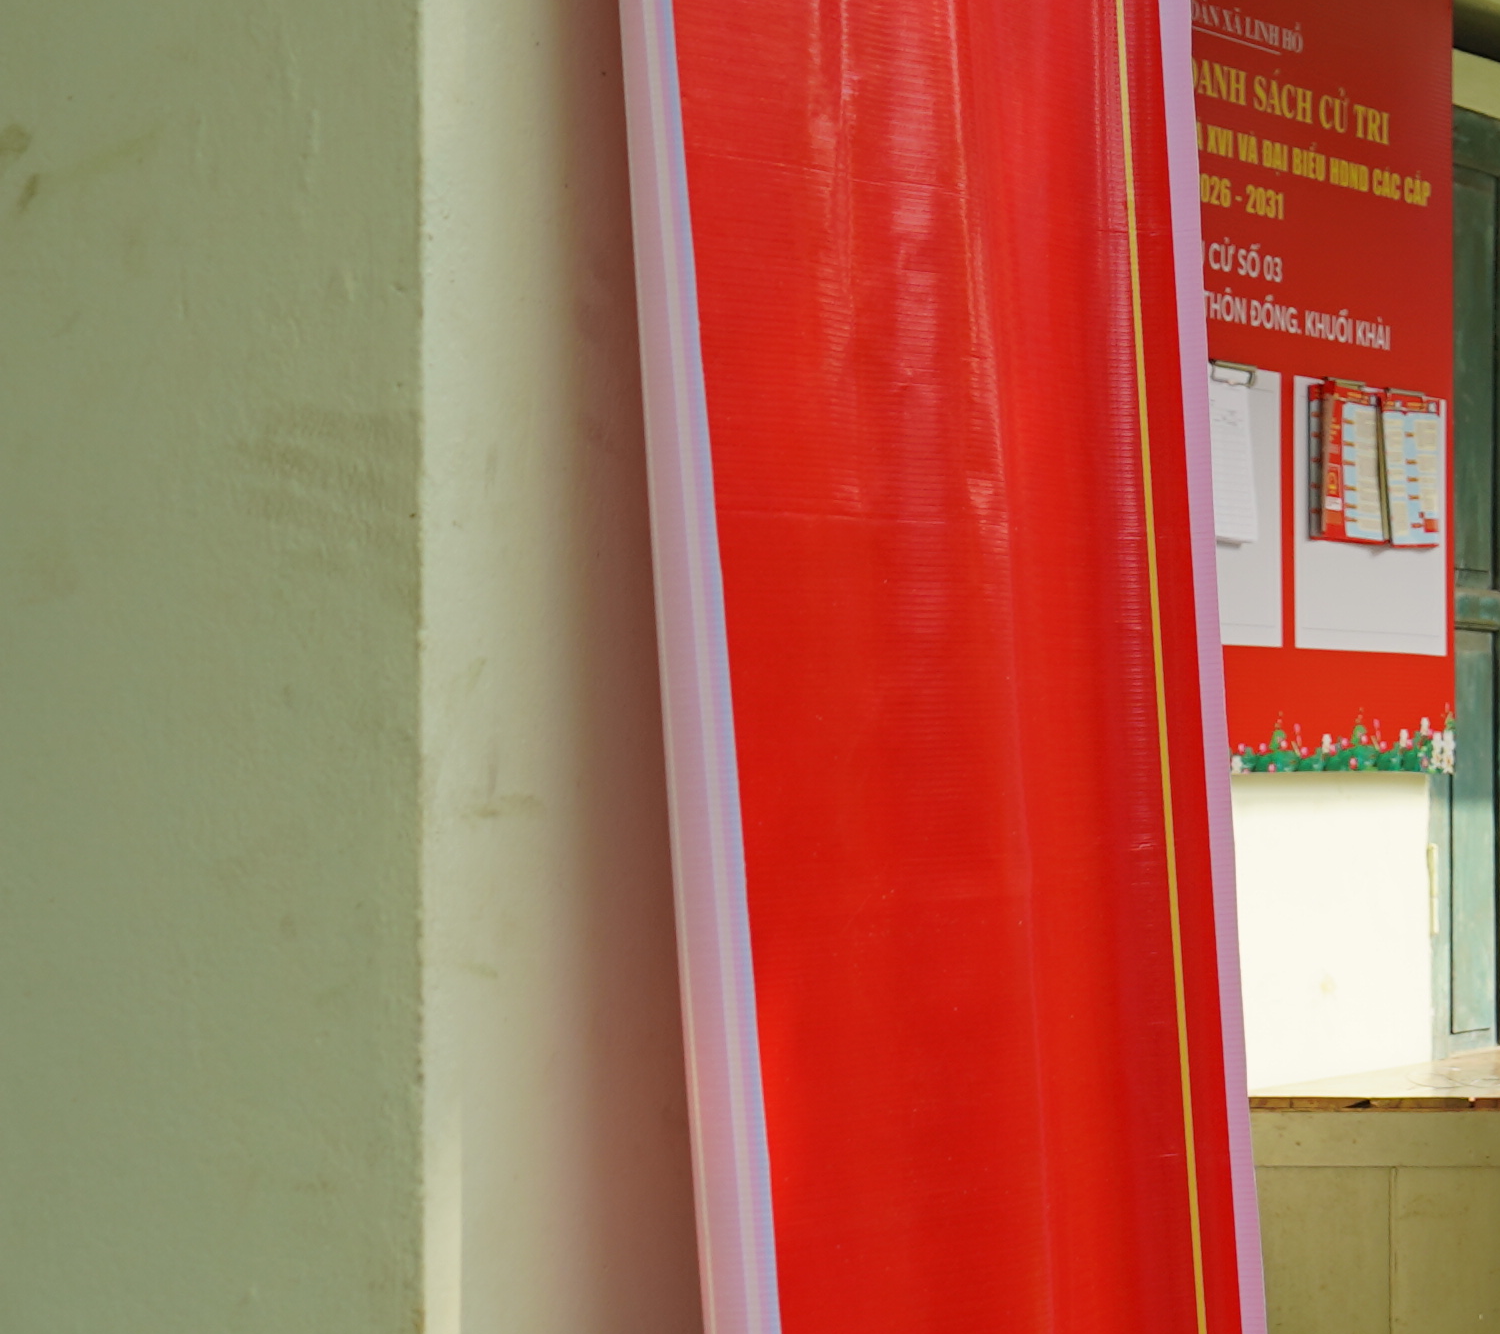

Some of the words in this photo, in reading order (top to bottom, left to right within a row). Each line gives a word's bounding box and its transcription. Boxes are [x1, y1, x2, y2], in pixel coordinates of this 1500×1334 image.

[1245, 16, 1280, 47] LINH
[1192, 58, 1247, 106] ANH
[1253, 68, 1313, 124] SÁCH
[1318, 87, 1349, 133] CỬ
[1353, 103, 1390, 145] TRI
[1206, 124, 1234, 159] XVI
[1237, 130, 1259, 165] VÀ
[1261, 139, 1288, 177] ĐẠI
[1292, 141, 1326, 182] BIỂU
[1372, 166, 1401, 201] CÁC
[1404, 169, 1432, 207] CẤP
[1200, 173, 1231, 208] 026
[1245, 184, 1285, 220] 2031
[1208, 237, 1236, 273] CỬ
[1237, 243, 1261, 278] SỐ
[1263, 254, 1283, 283] 03
[1355, 316, 1391, 351] KHÀI
